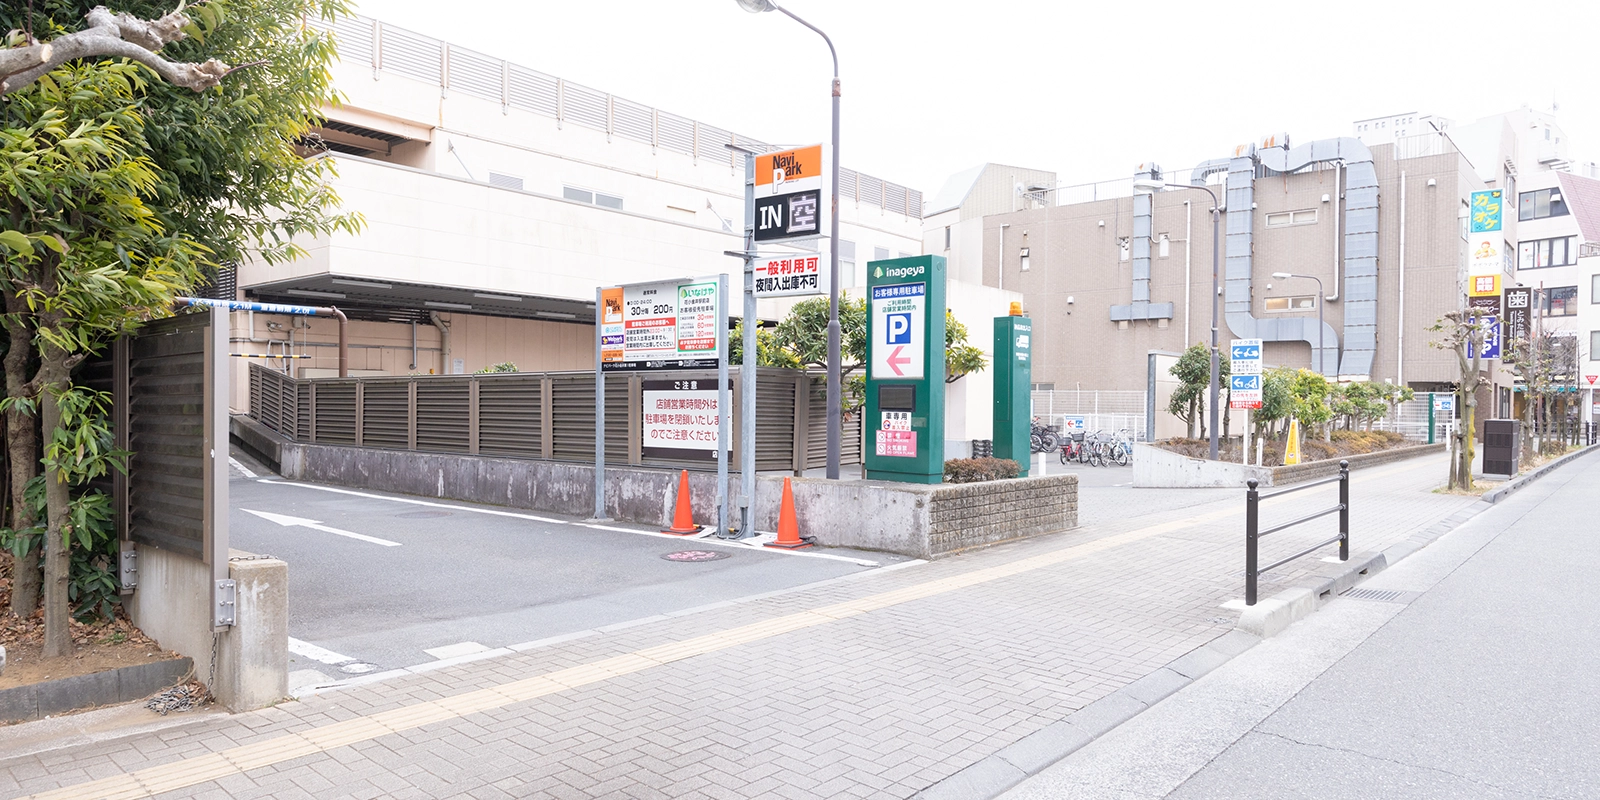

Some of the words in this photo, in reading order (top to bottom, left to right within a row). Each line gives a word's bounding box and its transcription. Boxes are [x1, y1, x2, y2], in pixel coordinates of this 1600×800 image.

[773, 152, 795, 170] Navi
[773, 161, 803, 194] Park
[759, 204, 782, 230] IN
[790, 195, 817, 231] 空
[1474, 193, 1500, 230] カラオケ
[755, 257, 819, 276] 一般利用可
[886, 265, 925, 278] inageya
[755, 273, 819, 293] 夜間入出庫不可
[874, 285, 924, 298] お客様専用駐車場
[605, 298, 618, 307] Navi
[1507, 291, 1529, 308] 歯
[653, 304, 673, 314] 200円
[889, 315, 909, 343] P
[674, 380, 698, 390] ご注意
[656, 399, 718, 410] 店舗営業時間外は
[645, 414, 730, 425] 駐車場を閉鎖いたしま
[886, 412, 908, 420] 車専用
